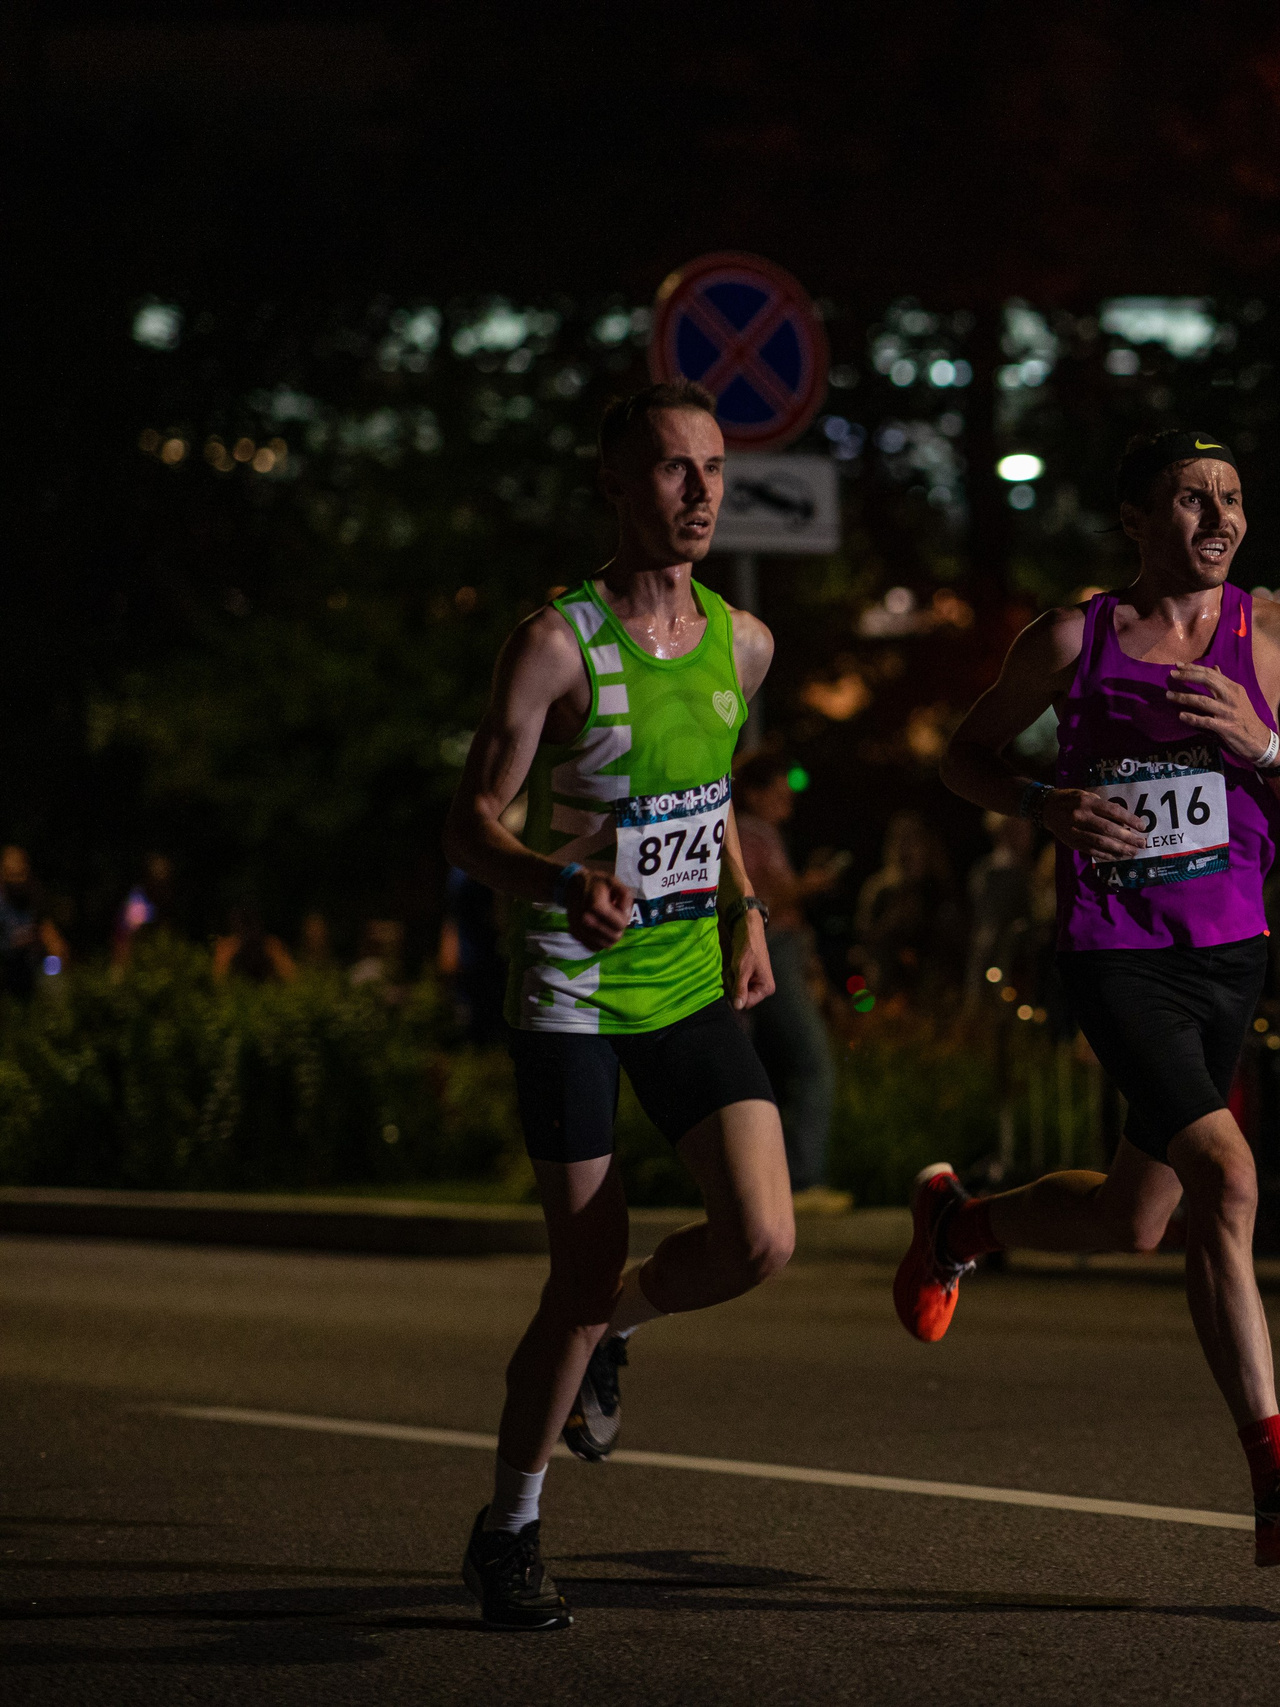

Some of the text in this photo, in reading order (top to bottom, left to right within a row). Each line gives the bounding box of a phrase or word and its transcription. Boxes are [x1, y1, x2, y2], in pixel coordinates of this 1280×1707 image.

[637, 819, 725, 876] 8749
[1145, 833, 1185, 849] LEXEY
[661, 868, 708, 888] ЭДУАРД
